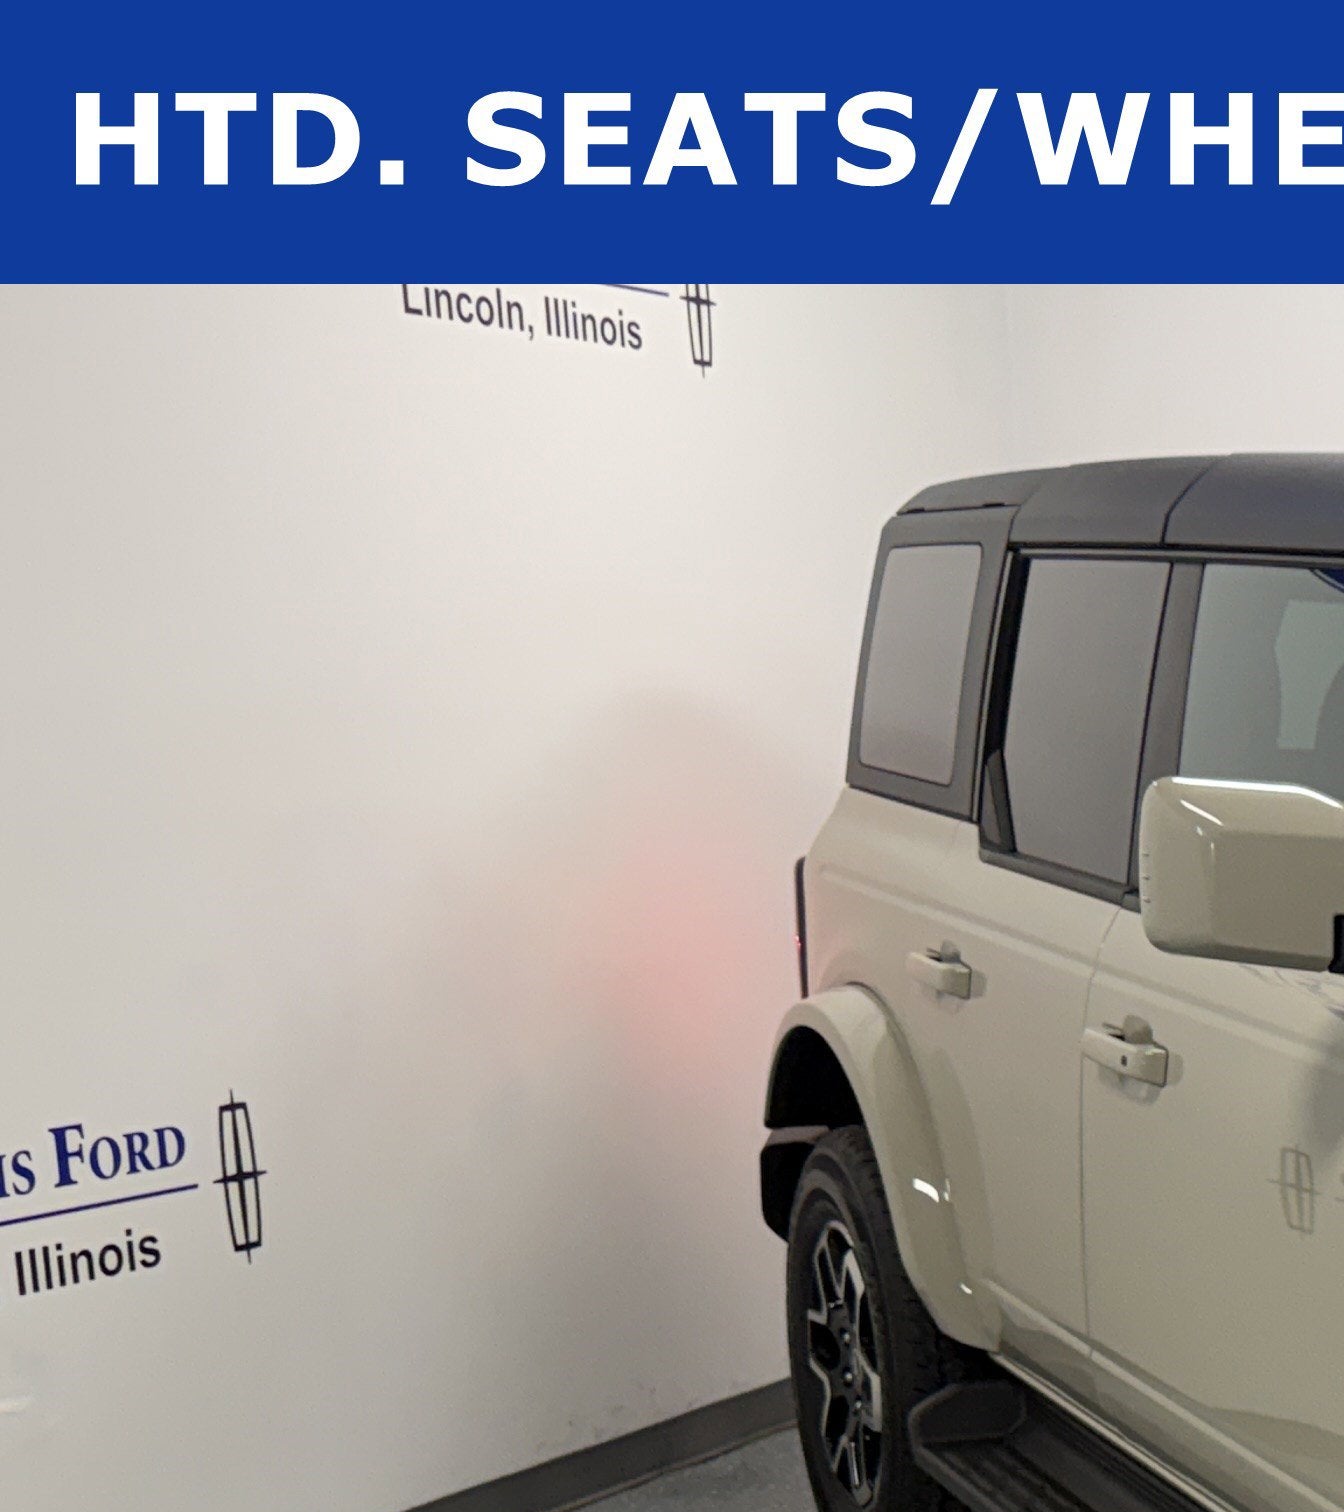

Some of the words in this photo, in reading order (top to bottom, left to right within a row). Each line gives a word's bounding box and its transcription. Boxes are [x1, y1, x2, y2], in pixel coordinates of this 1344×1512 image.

[401, 284, 534, 341] Lincoln,
[544, 296, 643, 350] Illinois
[48, 1123, 186, 1188] FORD
[14, 1228, 161, 1296] Illinois
